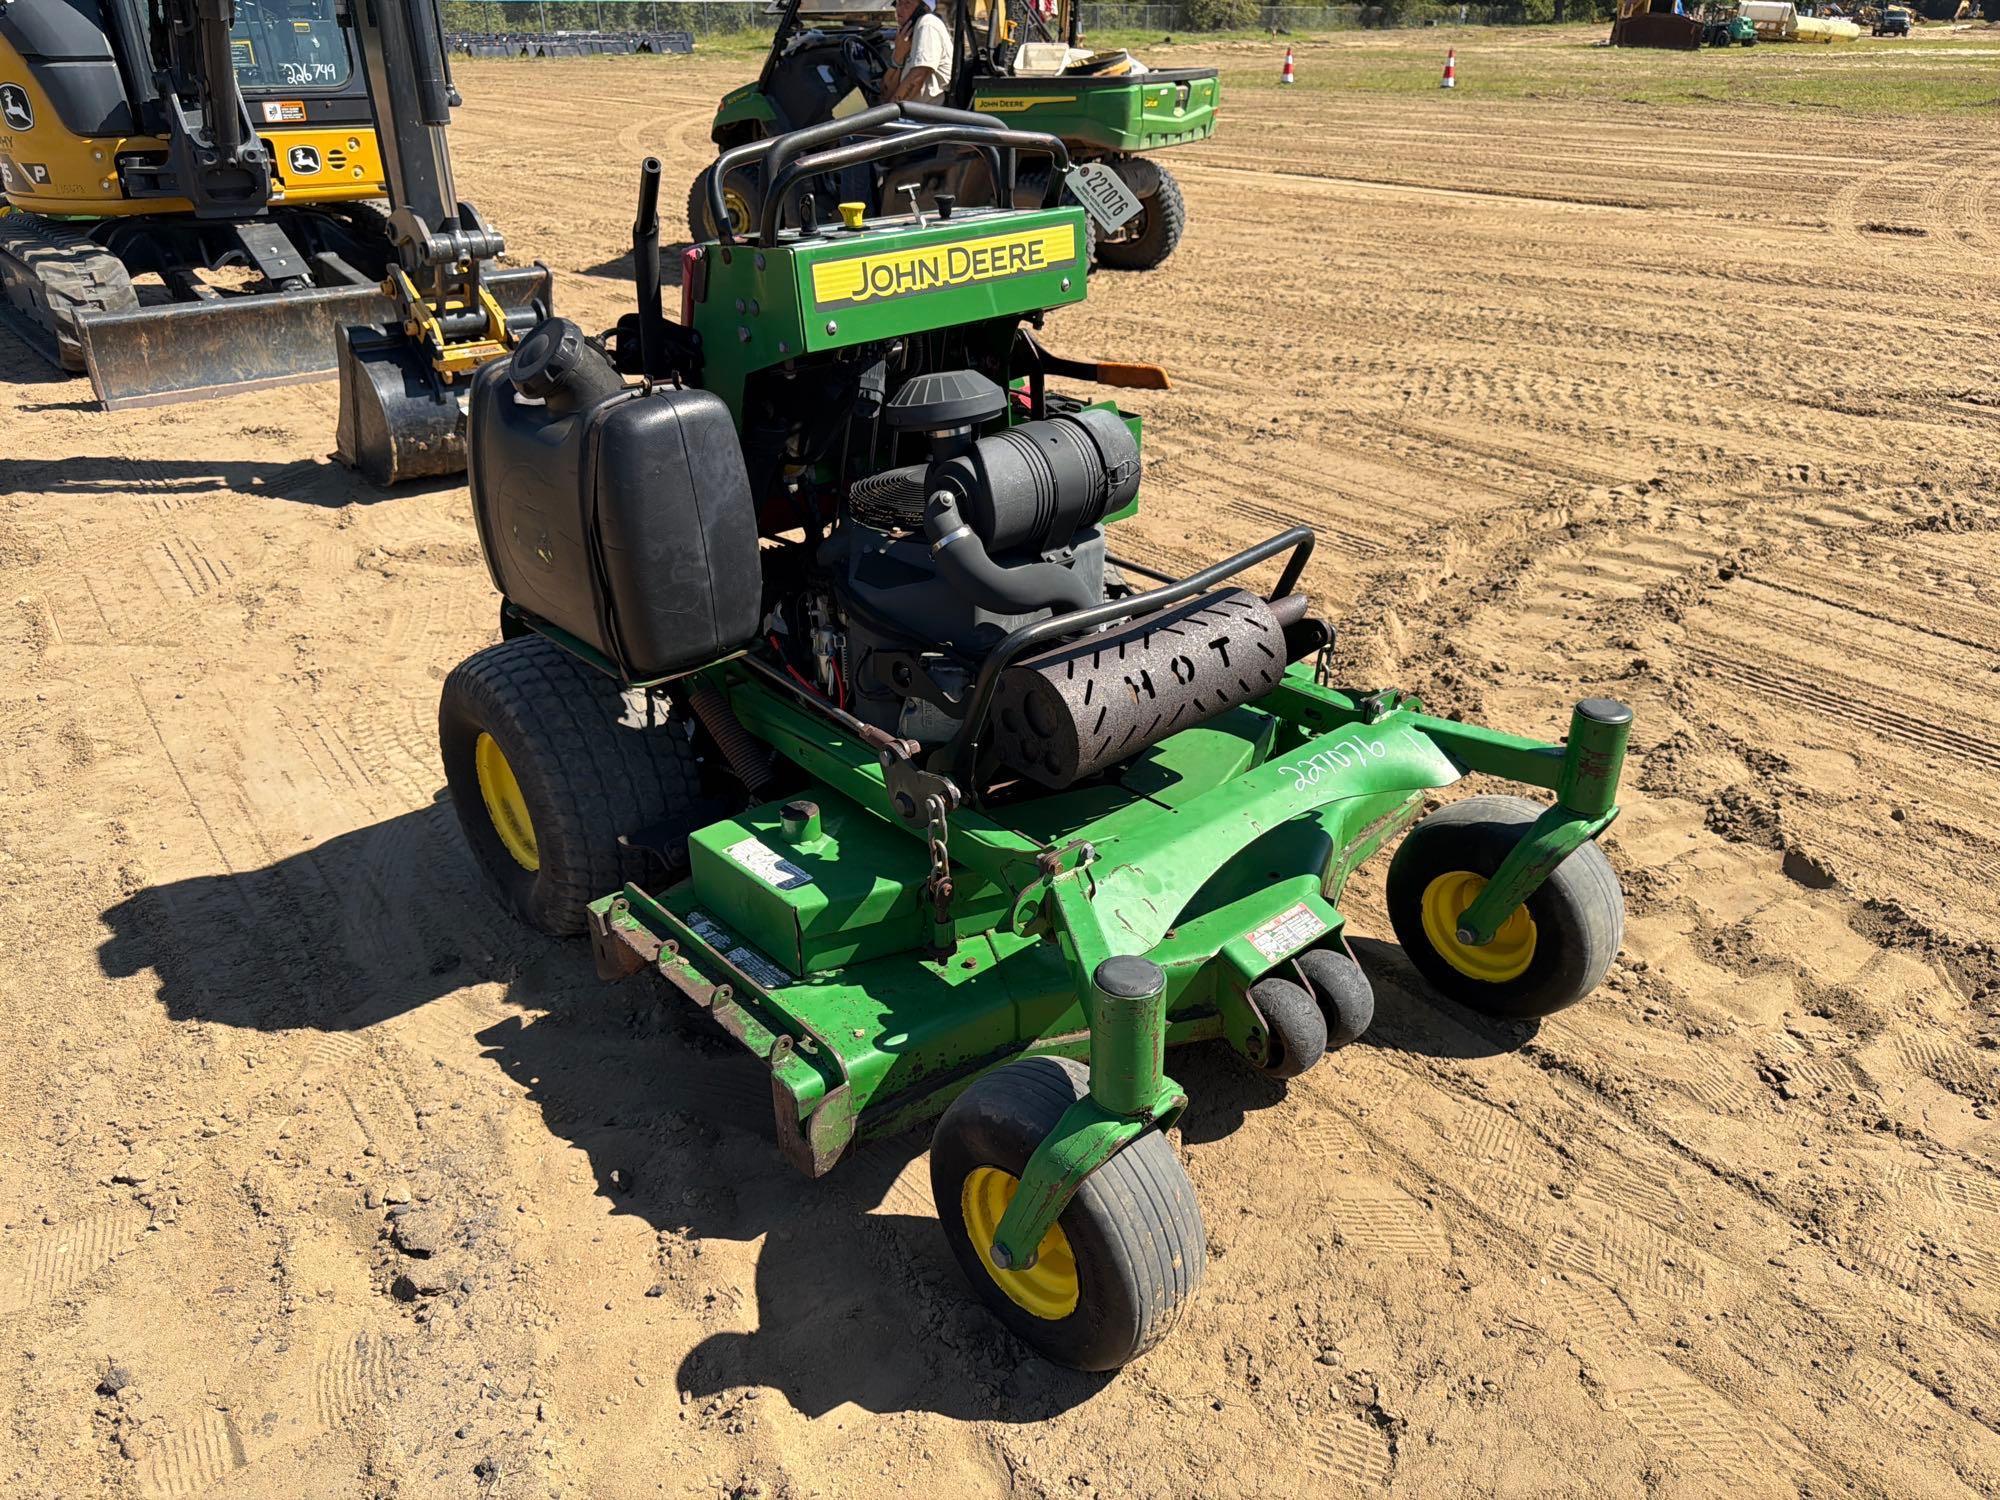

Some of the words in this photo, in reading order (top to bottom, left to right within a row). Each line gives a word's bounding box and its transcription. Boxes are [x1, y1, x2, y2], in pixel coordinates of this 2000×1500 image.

[284, 63, 336, 85] 226749
[33, 165, 46, 182] P
[1086, 171, 1129, 216] 227076
[852, 257, 940, 297] JOHN
[947, 240, 1044, 280] DEERE
[1124, 636, 1230, 705] HOT
[1278, 735, 1386, 791] 227076
